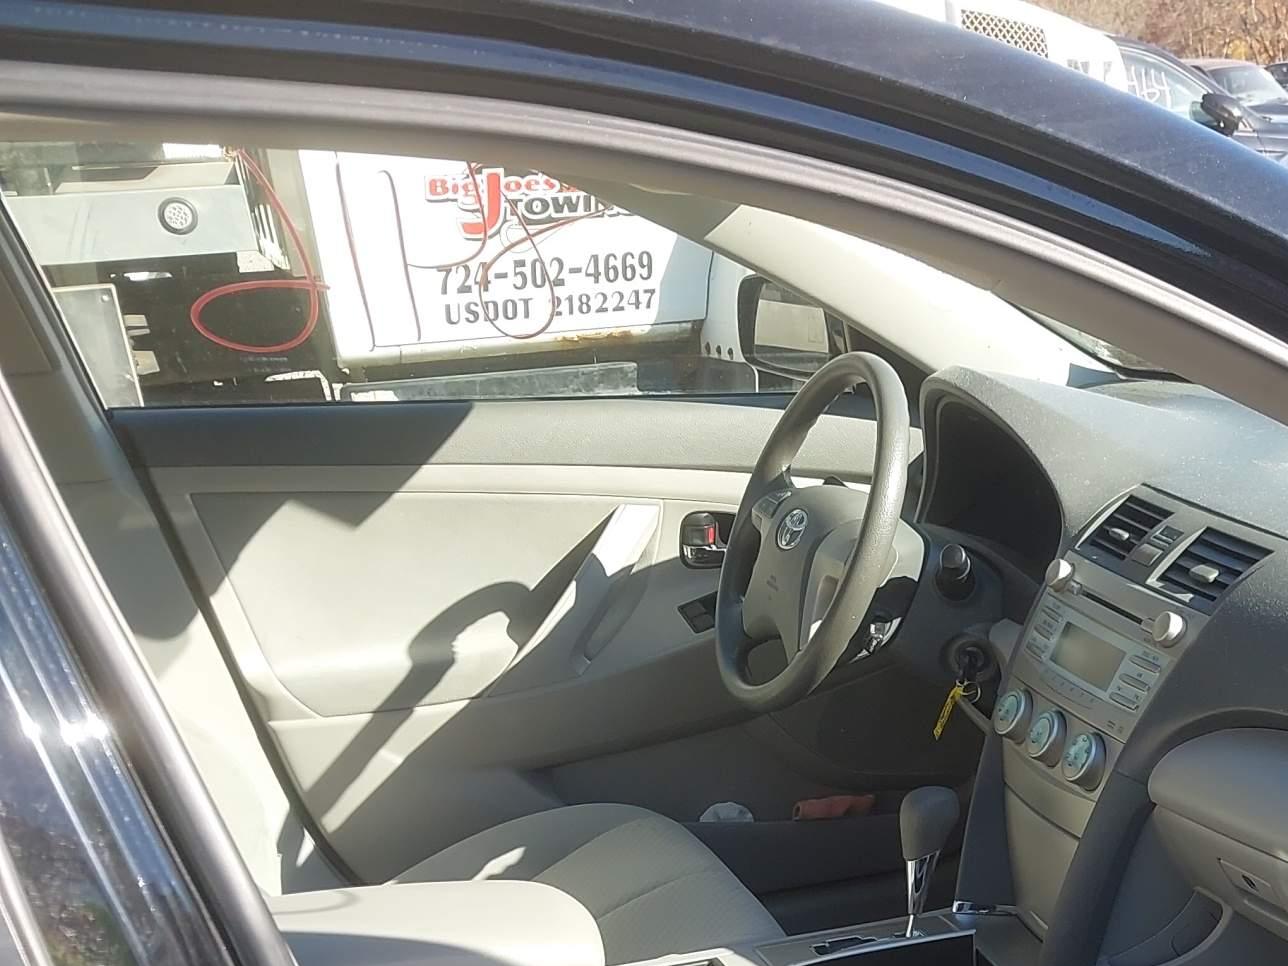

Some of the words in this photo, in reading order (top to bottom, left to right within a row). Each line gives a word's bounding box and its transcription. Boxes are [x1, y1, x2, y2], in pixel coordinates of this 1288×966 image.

[436, 250, 654, 295] 724-502-4669
[444, 297, 534, 325] USDOT
[550, 288, 656, 317] 2182247
